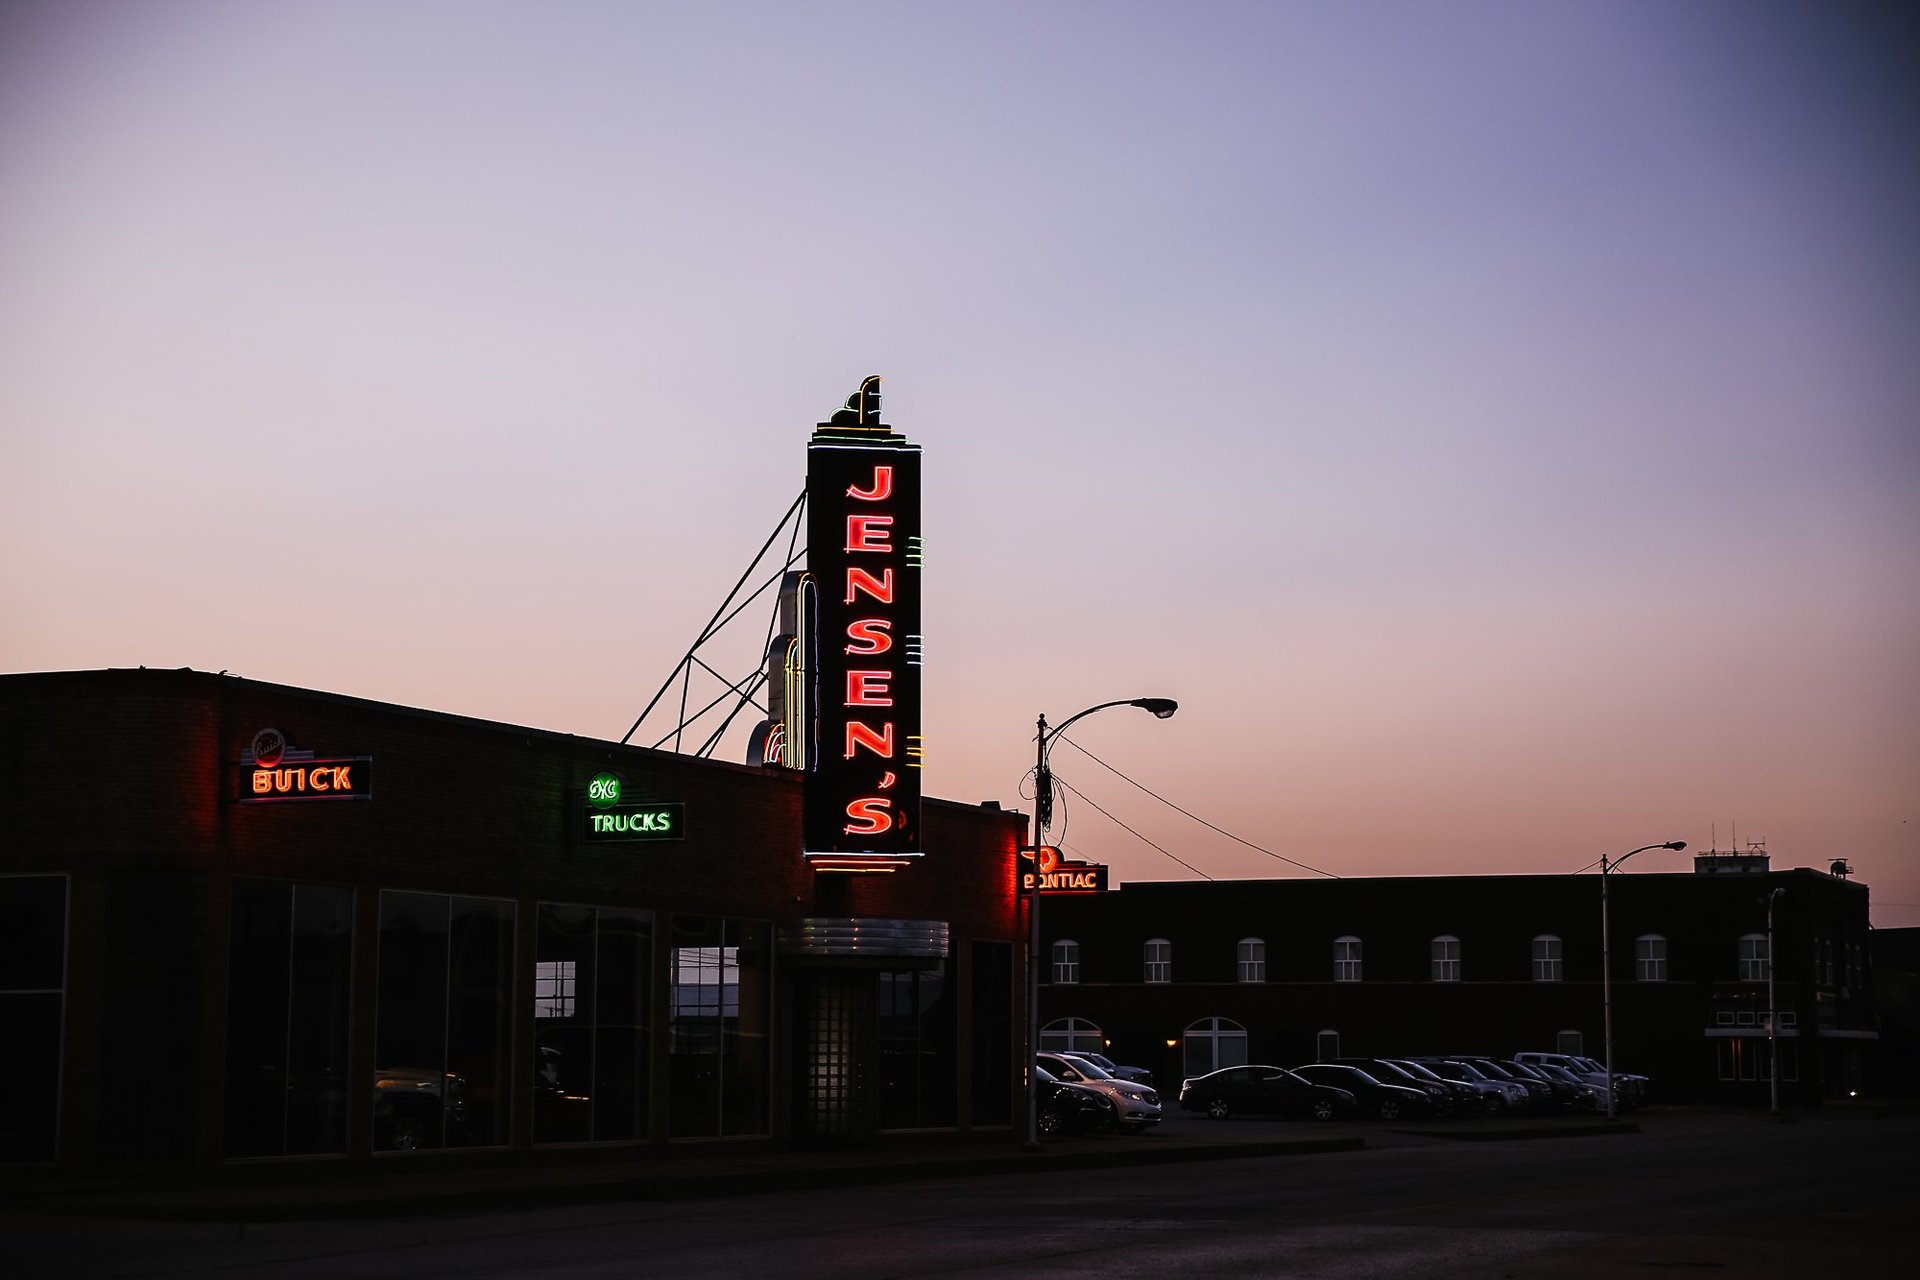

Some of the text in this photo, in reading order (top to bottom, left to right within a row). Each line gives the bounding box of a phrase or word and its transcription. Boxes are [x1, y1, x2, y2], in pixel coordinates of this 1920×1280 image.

[844, 466, 895, 835] JENSEN'S
[253, 766, 351, 793] BUICK
[590, 812, 671, 832] TRUCKS
